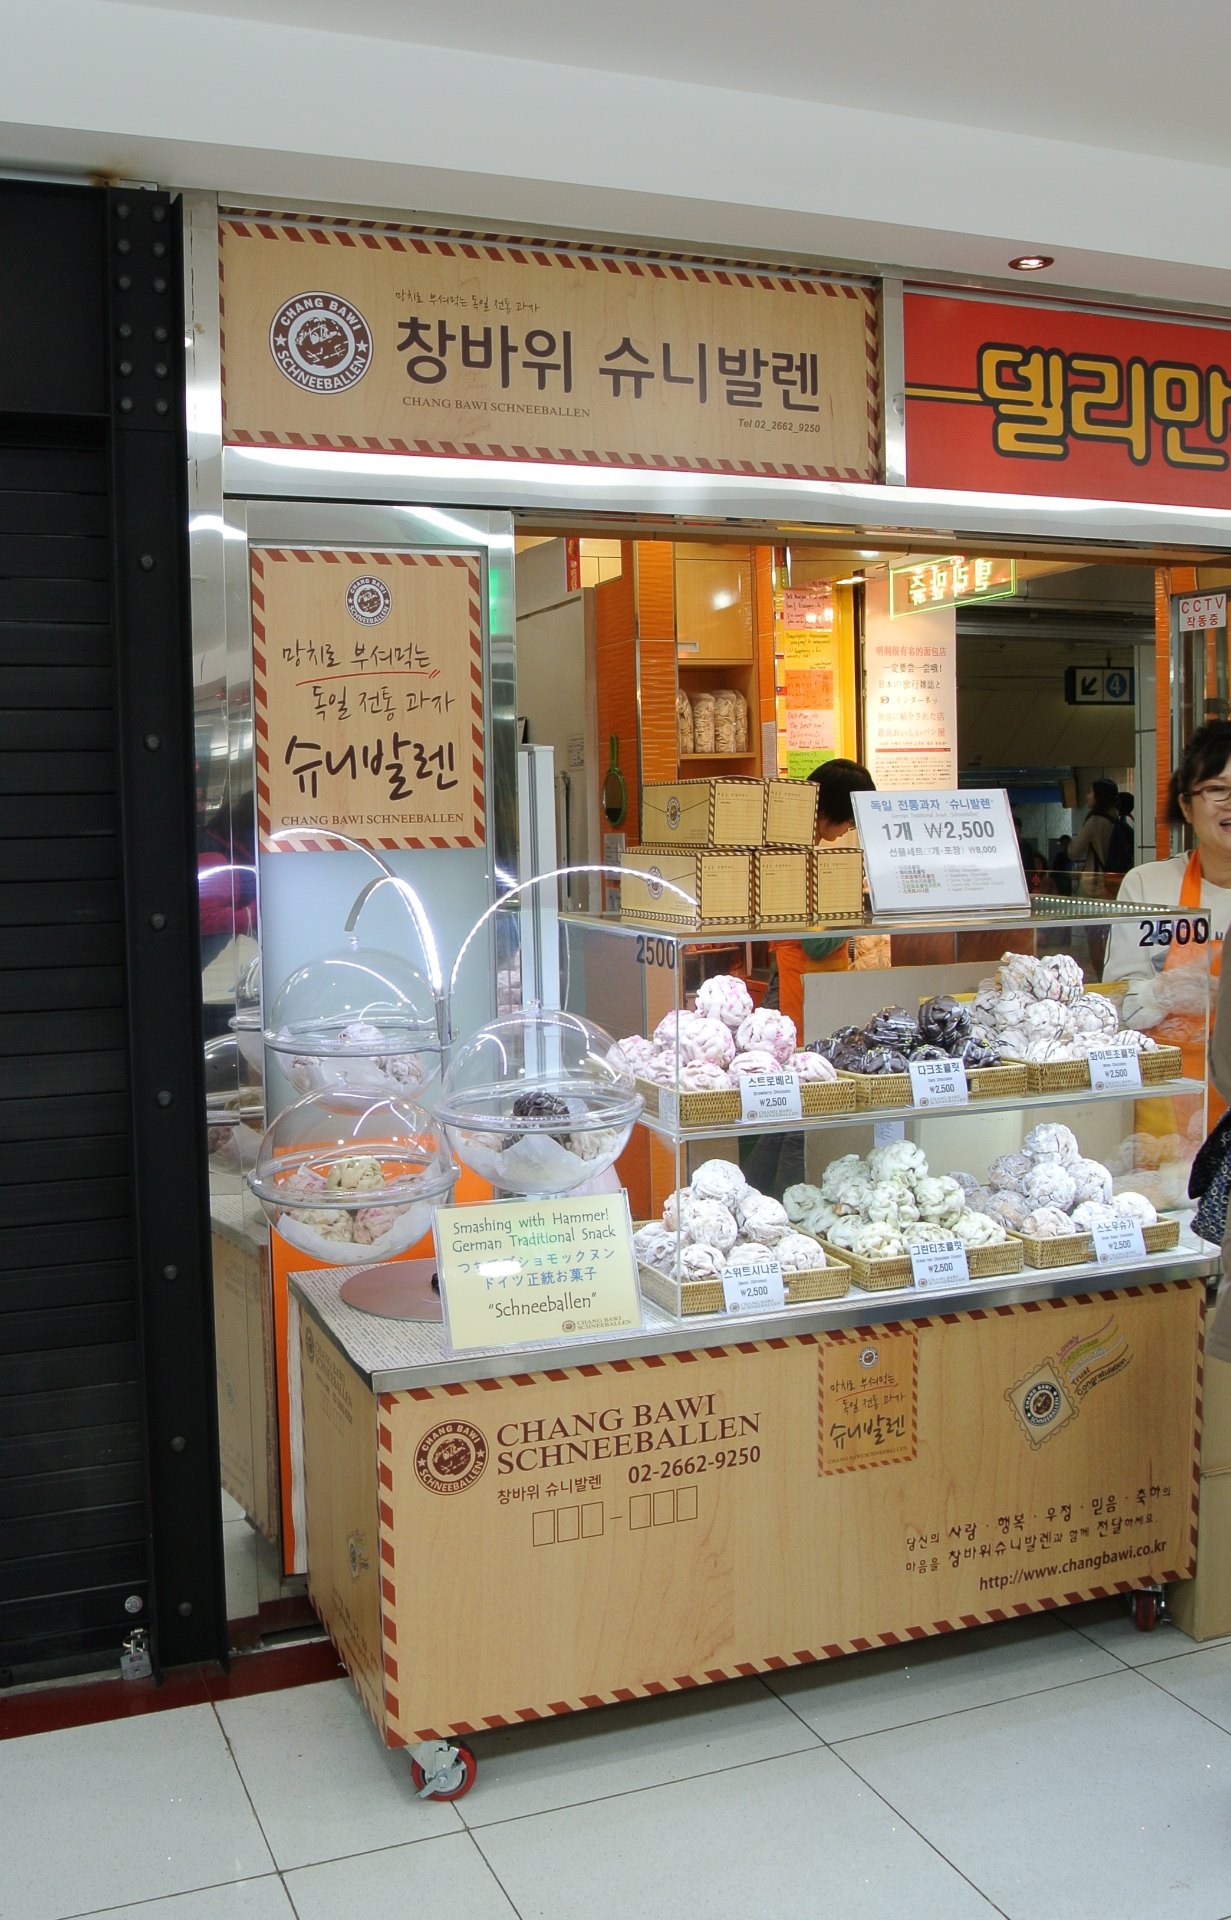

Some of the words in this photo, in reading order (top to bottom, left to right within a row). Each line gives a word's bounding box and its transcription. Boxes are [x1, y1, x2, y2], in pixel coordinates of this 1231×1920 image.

[280, 298, 324, 326] CHANG
[329, 301, 362, 331] BAWI
[395, 289, 424, 304] 망치로
[471, 294, 490, 313] 독일
[494, 297, 512, 316] 전통
[516, 301, 540, 314] 과자
[277, 350, 366, 390] SCHNEEBALLEN
[397, 316, 571, 393] 창바위
[599, 336, 820, 413] 슈니발렌
[402, 396, 451, 409] CHANG
[455, 400, 488, 411] BAWI
[490, 403, 591, 418] SCHNEEBALLEN
[738, 417, 752, 429] Tel
[754, 418, 821, 434] 02_2662_9250
[1181, 597, 1224, 615] CCTV
[1187, 613, 1219, 629] 작동중
[282, 639, 341, 668] 망치로
[1108, 675, 1122, 695] 4
[312, 686, 352, 721] 독일
[358, 686, 397, 722] 전통
[405, 690, 455, 714] 과자
[285, 732, 458, 801] 슈니발렌
[281, 816, 328, 826] CHANG
[332, 815, 364, 825] BAWI
[366, 812, 464, 825] SCHNEEBALLEN
[871, 800, 893, 812] 독일
[898, 799, 941, 811] 전통과자
[882, 821, 914, 841] 1개
[1139, 918, 1209, 947] 2500
[637, 935, 675, 969] 2500
[748, 1075, 794, 1087] 스트로베리
[453, 1217, 512, 1235] Smashing
[518, 1212, 545, 1228] with
[552, 1208, 609, 1225] Hammer!
[452, 1240, 502, 1253] German
[509, 1228, 575, 1247] Traditional
[582, 1225, 616, 1241] Snack
[486, 1266, 597, 1290] ドイツ正統お菓子
[723, 1263, 779, 1279] 스위트시나몬
[1071, 1366, 1091, 1385] Trust
[1077, 1358, 1127, 1396] Congratulation
[496, 1408, 624, 1447] CHANG
[632, 1393, 717, 1427] BAWI
[830, 1414, 906, 1449] 슈니발렌
[421, 1425, 453, 1452] CHANG
[456, 1425, 481, 1443] BAWI
[496, 1412, 762, 1475] SCHNEEBALLEN
[420, 1460, 484, 1492] SCHNEEBALLEN
[628, 1445, 761, 1484] 02-2662-9250
[497, 1483, 540, 1505] 창바위
[545, 1474, 602, 1498] 슈니발렌
[906, 1532, 940, 1552] 당신의
[948, 1522, 978, 1541] 사랑
[997, 1513, 1025, 1535] 행복
[1045, 1503, 1072, 1522] 우정
[1091, 1494, 1117, 1516] 믿음
[1136, 1485, 1171, 1506] 축하의
[905, 1557, 940, 1574] 마음을
[1069, 1527, 1090, 1543] 함께
[979, 1540, 1167, 1591] http://www.changbawi.co.kr
